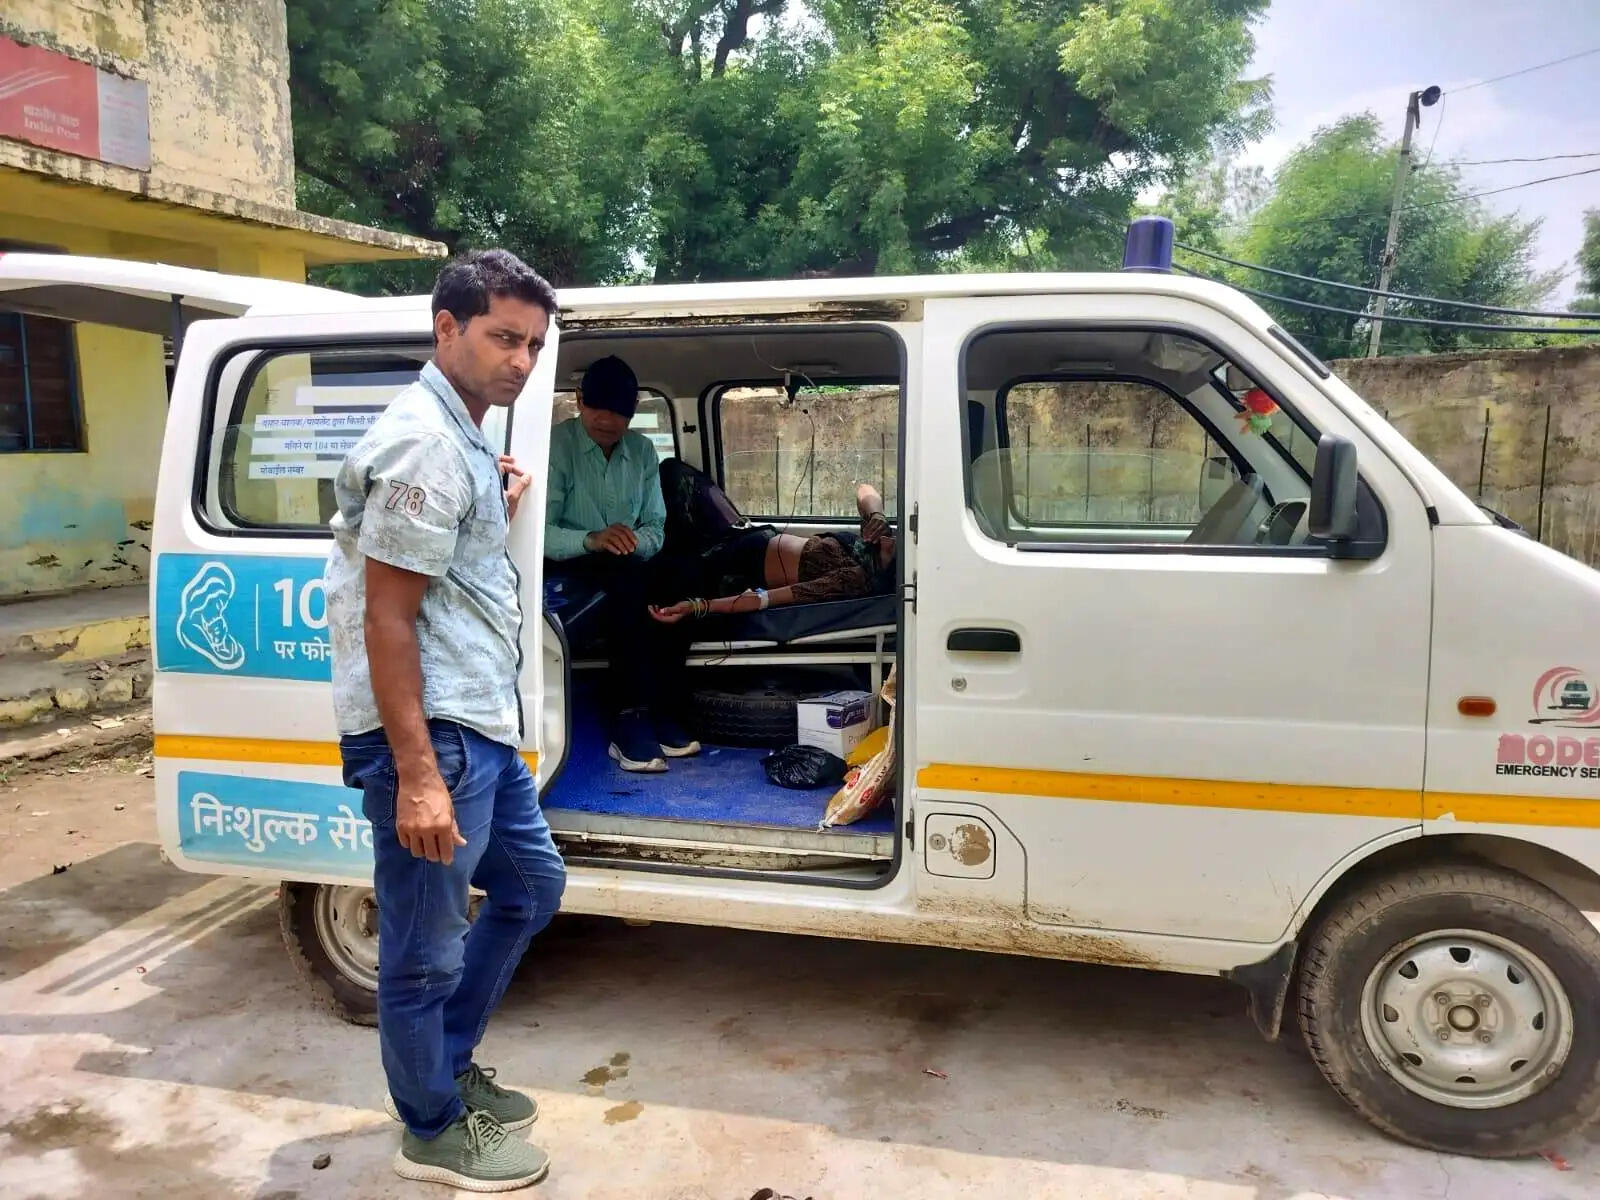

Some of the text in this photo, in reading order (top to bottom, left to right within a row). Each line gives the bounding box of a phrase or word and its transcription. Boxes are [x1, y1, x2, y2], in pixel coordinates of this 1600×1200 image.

[385, 480, 426, 516] 78
[273, 640, 296, 660] पर
[1496, 764, 1600, 779] EMERGENCY SE
[190, 792, 320, 852] निःशुल्क
